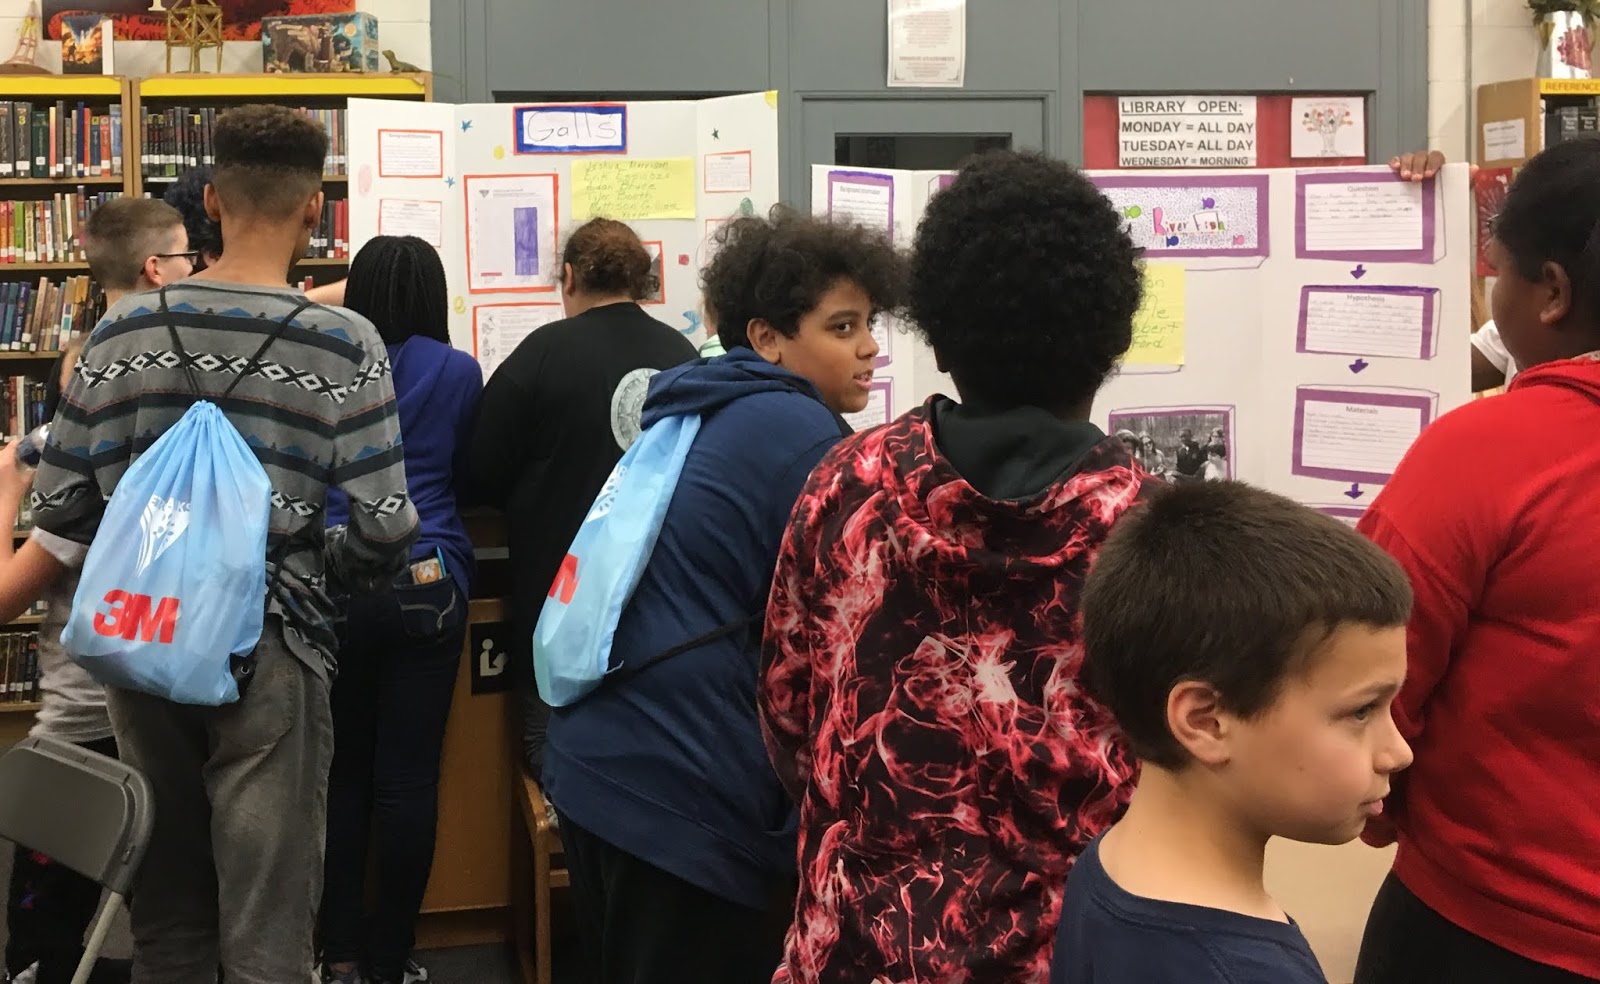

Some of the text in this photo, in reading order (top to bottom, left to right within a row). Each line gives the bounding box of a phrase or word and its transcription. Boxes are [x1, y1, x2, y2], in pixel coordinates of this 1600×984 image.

[1121, 101, 1242, 113] LIBRARY OPEN:
[528, 111, 616, 142] Galls
[1121, 121, 1181, 133] MONDAY
[1197, 122, 1223, 133] ALL
[1227, 122, 1254, 133] DAY
[1197, 140, 1223, 151] ALL
[1227, 140, 1254, 151] DAY
[1121, 157, 1188, 166] WEDNESDAY
[1199, 156, 1249, 166] MORNING
[1347, 185, 1379, 193] Question
[1347, 294, 1385, 303] Hypothesis
[1346, 405, 1379, 416] Materials
[93, 589, 180, 644] 3M
